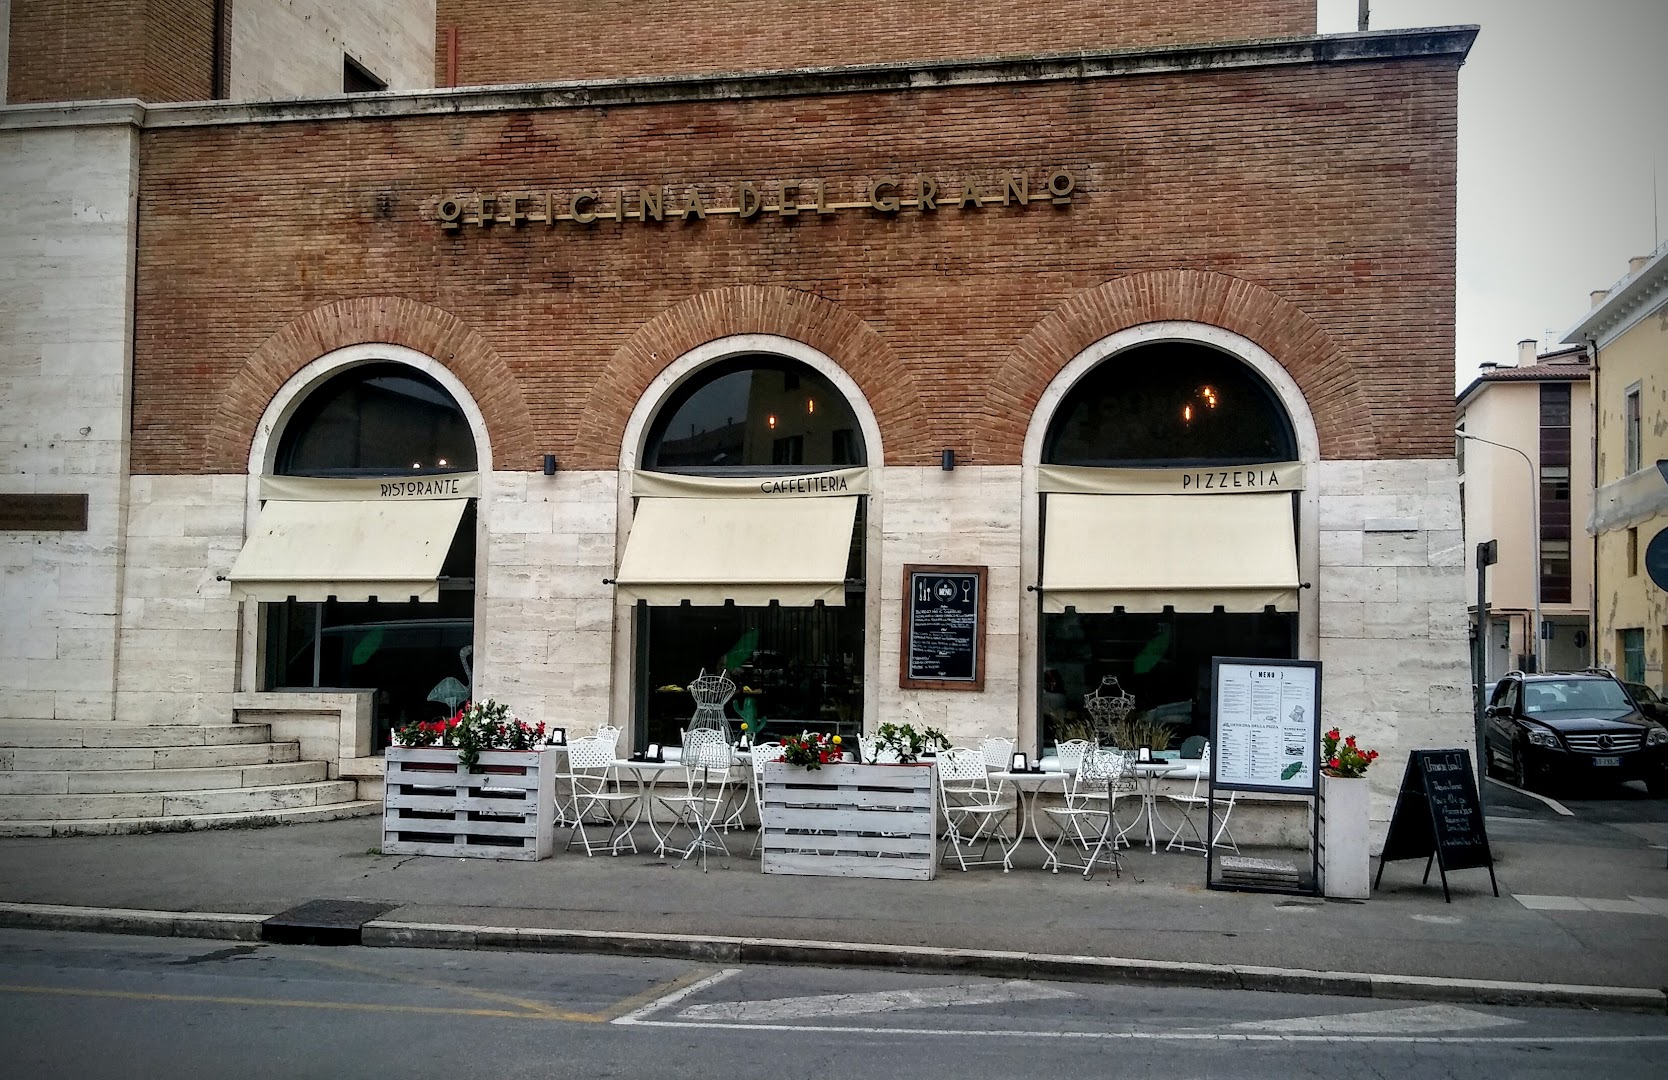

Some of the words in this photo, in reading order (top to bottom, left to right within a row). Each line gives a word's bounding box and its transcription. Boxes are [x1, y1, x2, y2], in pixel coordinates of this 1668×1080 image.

[437, 185, 706, 229] OFFICINA
[739, 177, 835, 218] DEL
[869, 169, 1075, 212] GRANO
[380, 479, 460, 497] RISTORANTE
[760, 476, 848, 493] CAFFETTERIA
[1183, 470, 1279, 489] PIZZERIA
